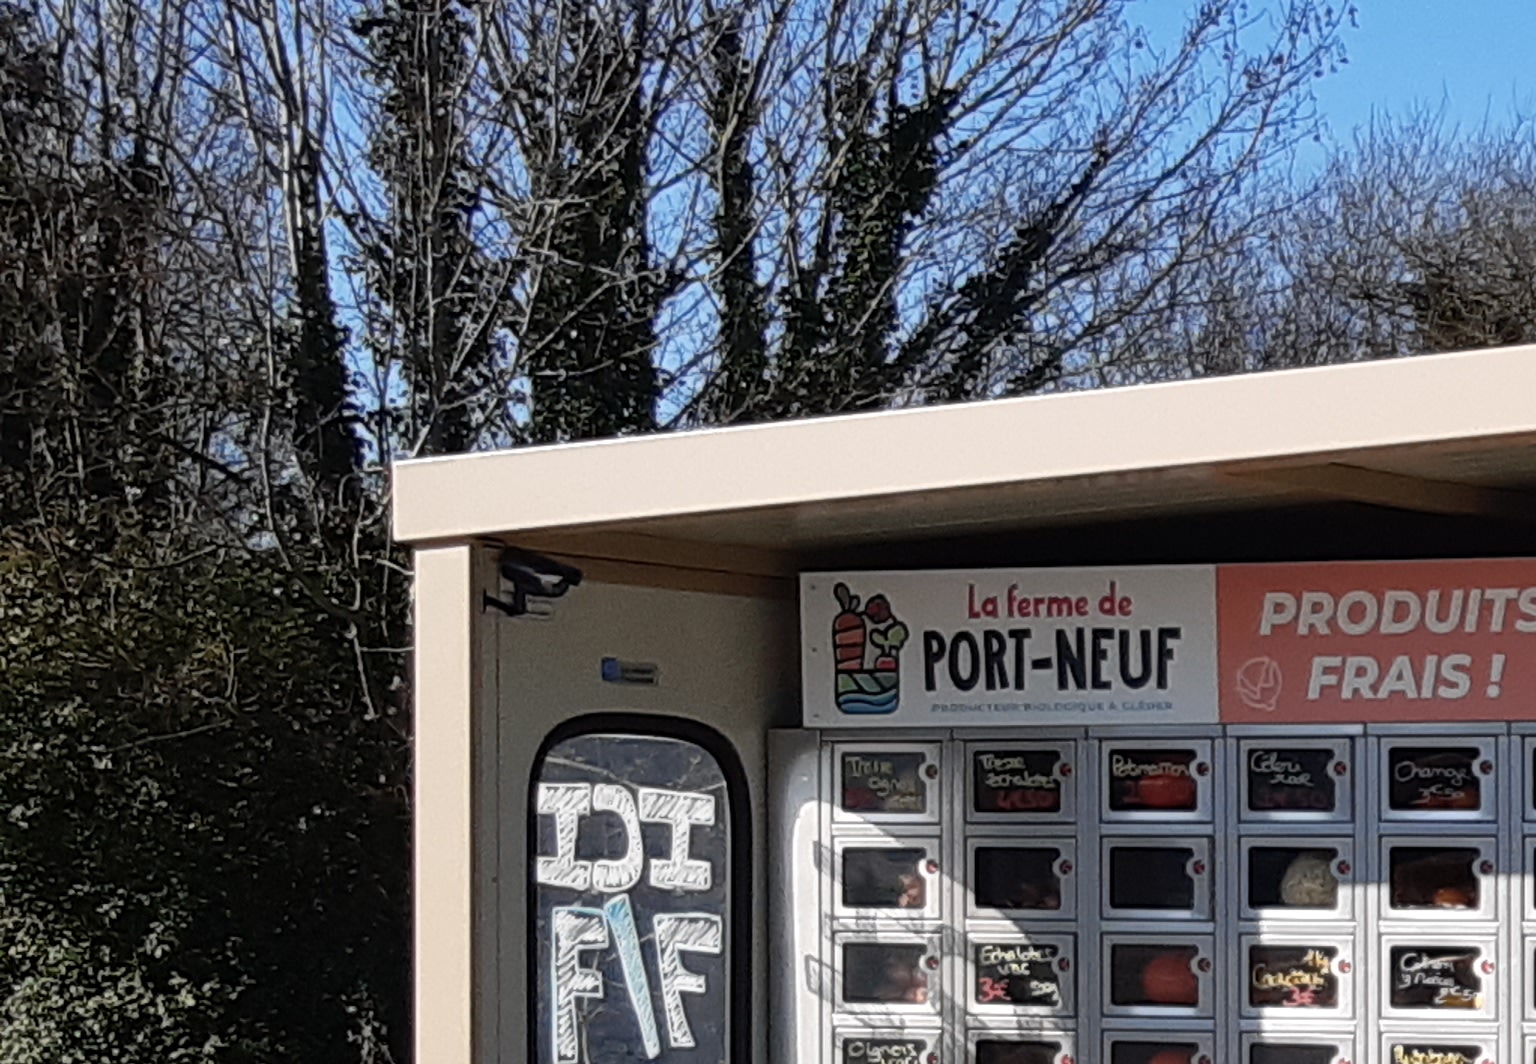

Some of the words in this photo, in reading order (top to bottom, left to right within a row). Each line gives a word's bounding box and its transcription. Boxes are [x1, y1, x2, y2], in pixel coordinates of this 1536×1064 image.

[968, 584, 998, 619] La
[1007, 583, 1088, 617] ferme
[1098, 580, 1133, 616] de
[923, 627, 1181, 691] PORT-NEUF
[1306, 654, 1472, 700] FRAIS
